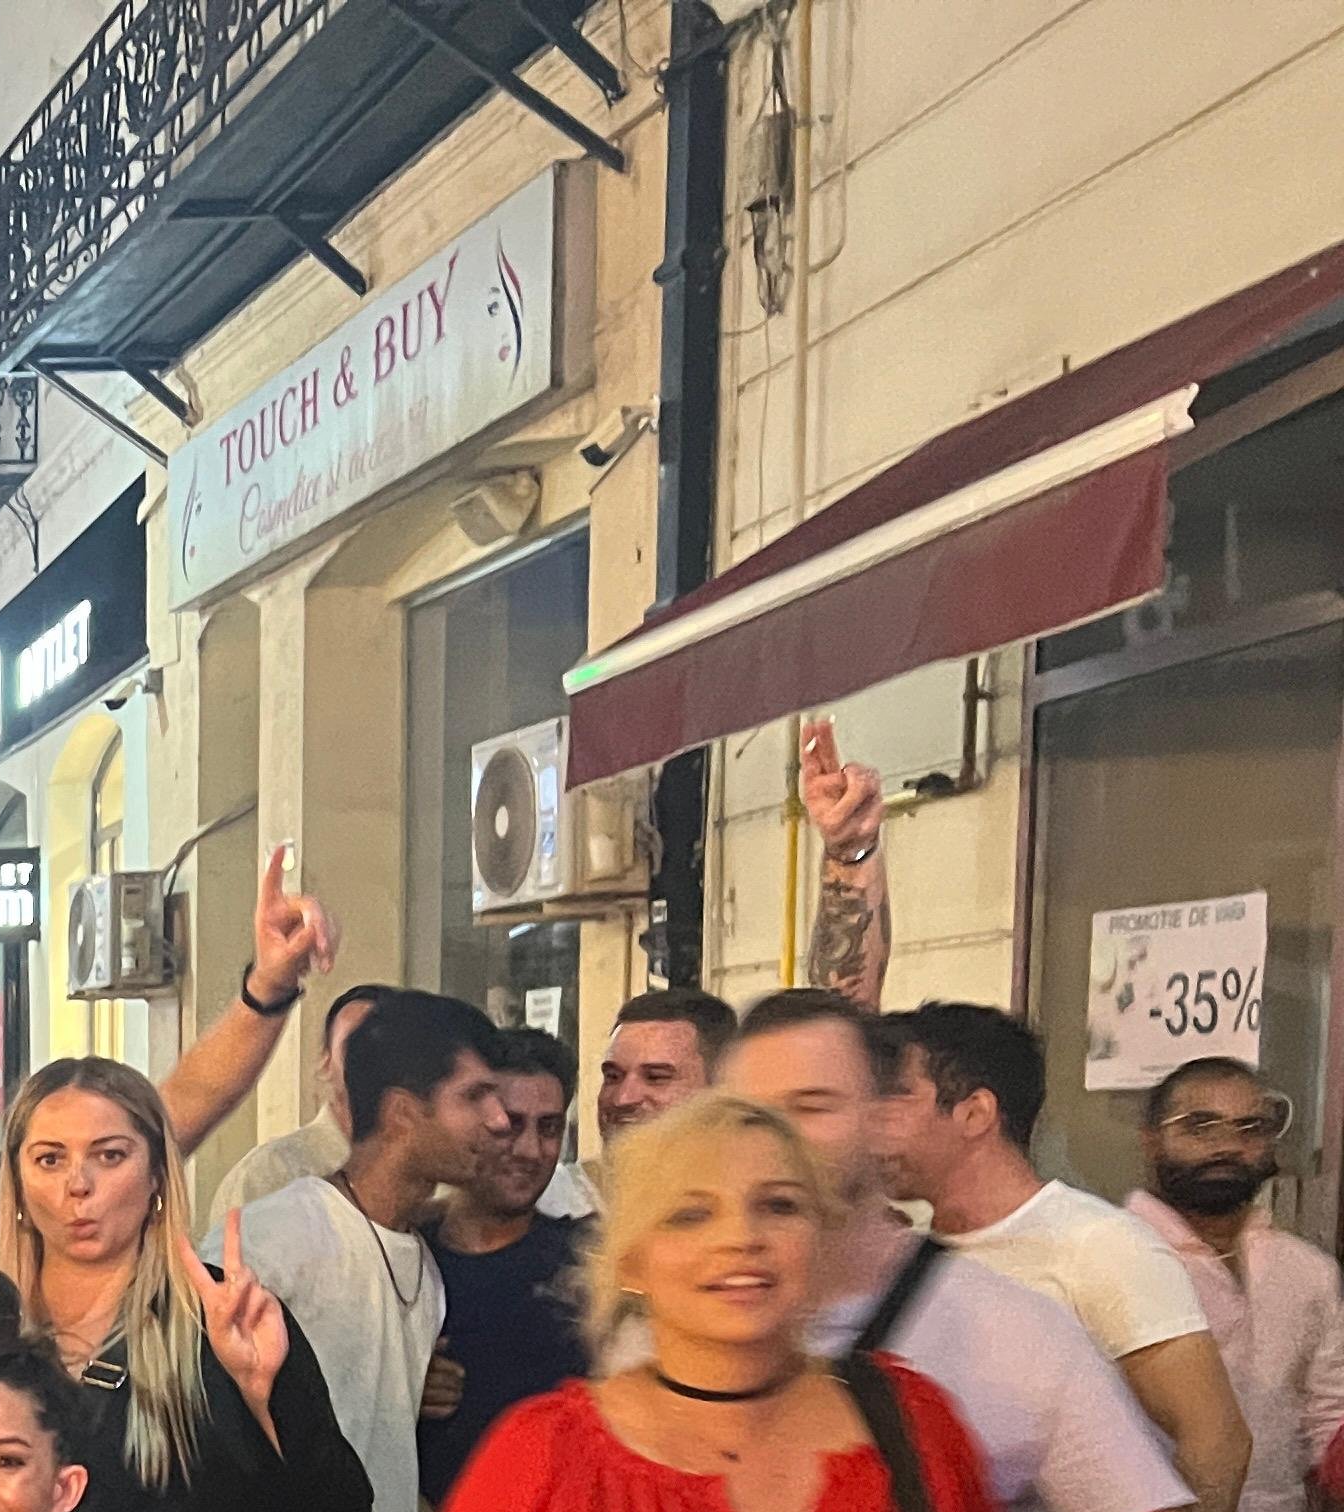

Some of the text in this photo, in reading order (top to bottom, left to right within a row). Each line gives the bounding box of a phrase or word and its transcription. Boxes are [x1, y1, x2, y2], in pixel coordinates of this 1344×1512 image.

[219, 367, 319, 486] TOUCH
[333, 345, 358, 407] &
[373, 250, 459, 385] BUY
[1188, 905, 1210, 928] DE
[1149, 966, 1262, 1037] -35%
